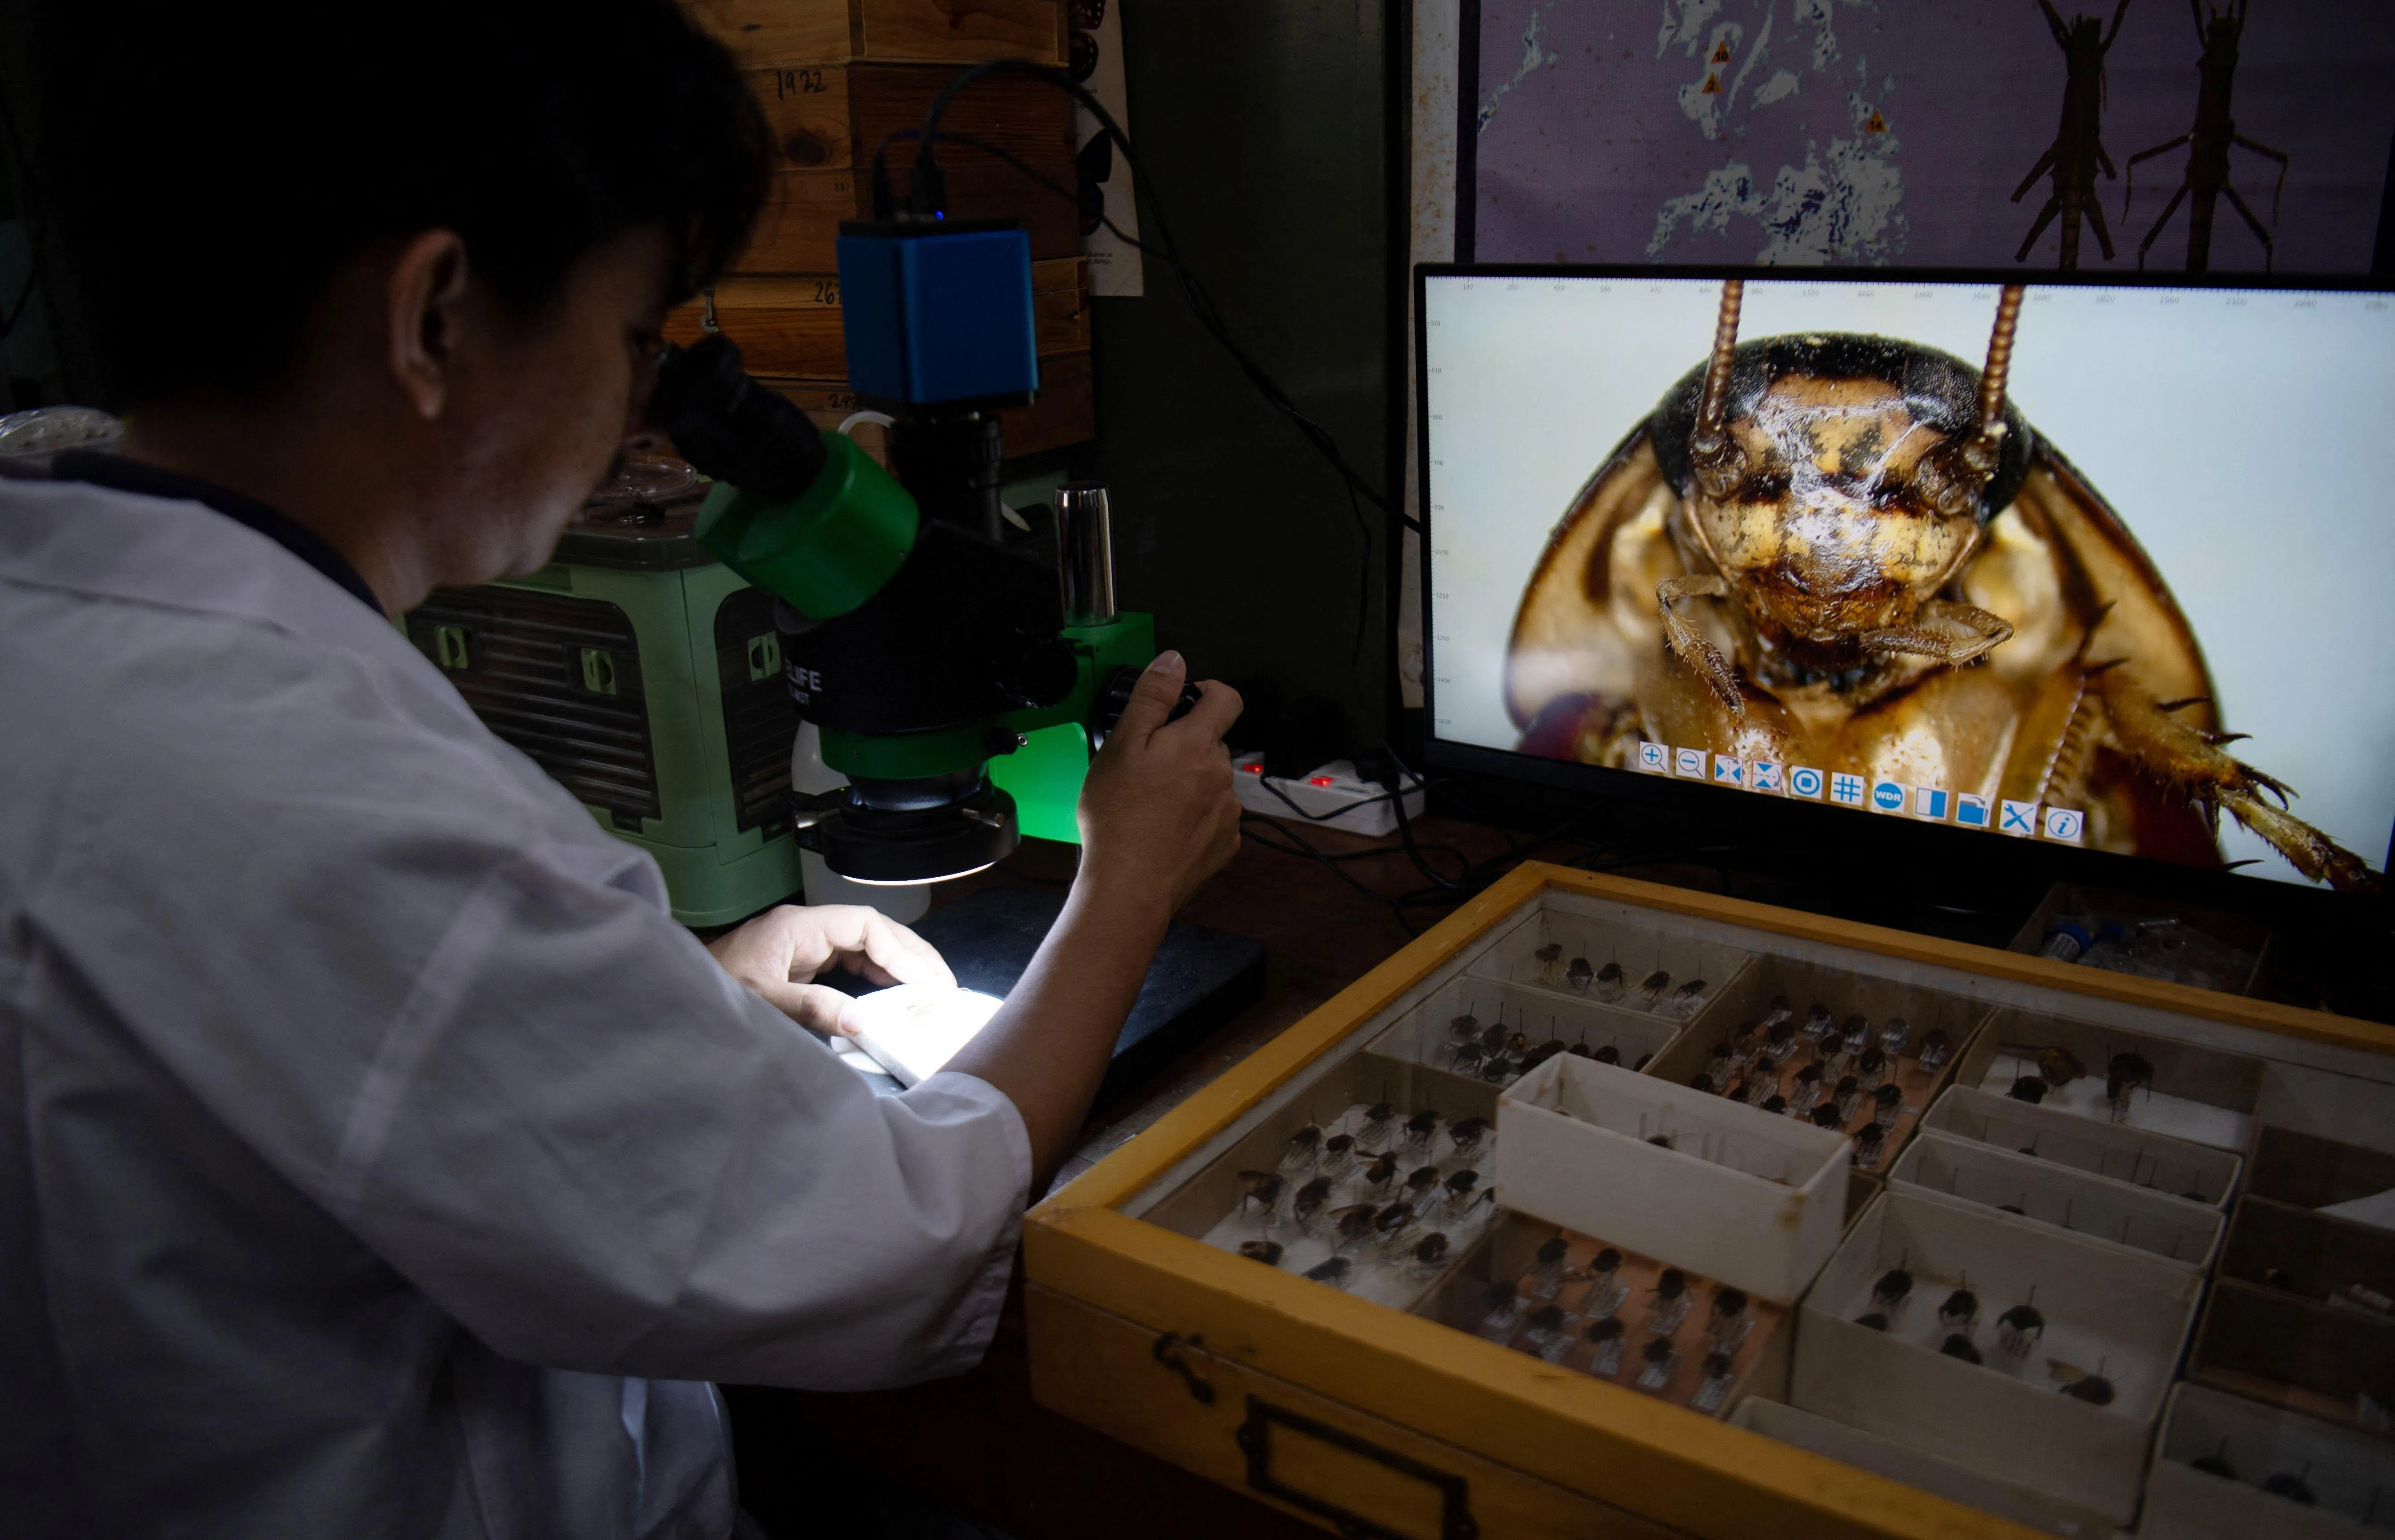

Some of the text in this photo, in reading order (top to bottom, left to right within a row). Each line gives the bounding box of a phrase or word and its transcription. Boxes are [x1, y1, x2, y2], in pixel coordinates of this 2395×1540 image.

[1715, 51, 1728, 61] 10
[777, 70, 826, 100] 1922
[1708, 81, 1715, 91] 2
[1876, 790, 1902, 802] WDR
